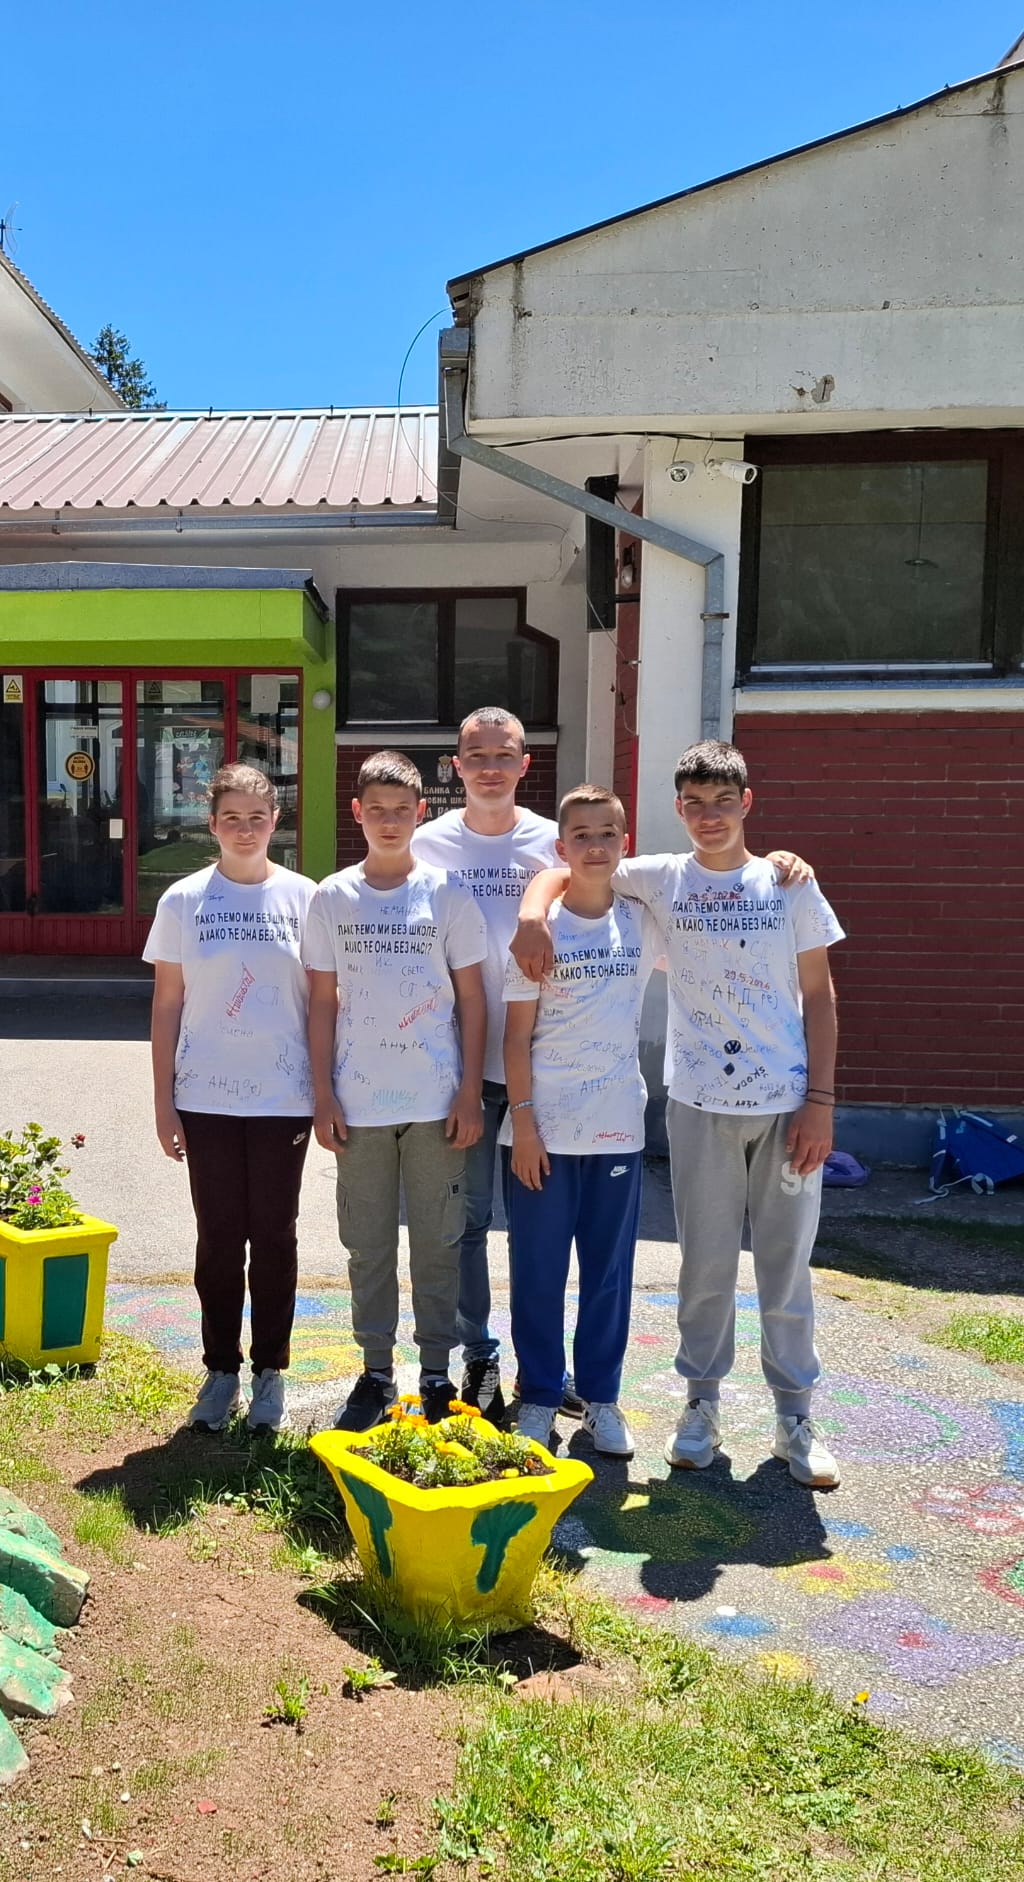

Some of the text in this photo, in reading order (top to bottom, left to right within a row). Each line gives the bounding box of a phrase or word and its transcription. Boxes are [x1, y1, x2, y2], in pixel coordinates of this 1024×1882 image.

[423, 786, 450, 795] БЛИКА
[461, 868, 486, 880] ЋЕМО
[487, 868, 500, 879] МИ
[501, 868, 517, 879] БЕЗ
[472, 884, 521, 897] ЋЕ ОНА БЕЗ
[695, 901, 720, 914] ЋЕМО
[721, 901, 738, 913] МИ
[737, 901, 755, 912] БЕЗ
[217, 912, 242, 923] ЋЕМО
[242, 912, 255, 923] МИ
[256, 913, 272, 924] БЕЗ
[354, 924, 376, 936] ЋЕМО
[377, 924, 391, 936] МИ
[391, 924, 408, 935] БЕЗ
[705, 919, 719, 932] ЋЕ
[720, 919, 740, 932] ОНА
[741, 918, 759, 931] БЕЗ
[199, 931, 205, 942] А
[227, 928, 240, 941] ЋЕ
[240, 929, 257, 941] ОНА
[258, 929, 275, 942] БЕЗ
[374, 941, 392, 953] ОНА
[393, 941, 410, 954] БЕЗ
[553, 953, 570, 965] АКО
[571, 948, 597, 962] ЋЕМО
[597, 947, 611, 959] МИ
[553, 968, 559, 979] А
[560, 966, 582, 980] КАКО
[584, 965, 597, 979] ЋЕ
[598, 964, 615, 978] ОНА
[615, 963, 629, 976] БЕЗ
